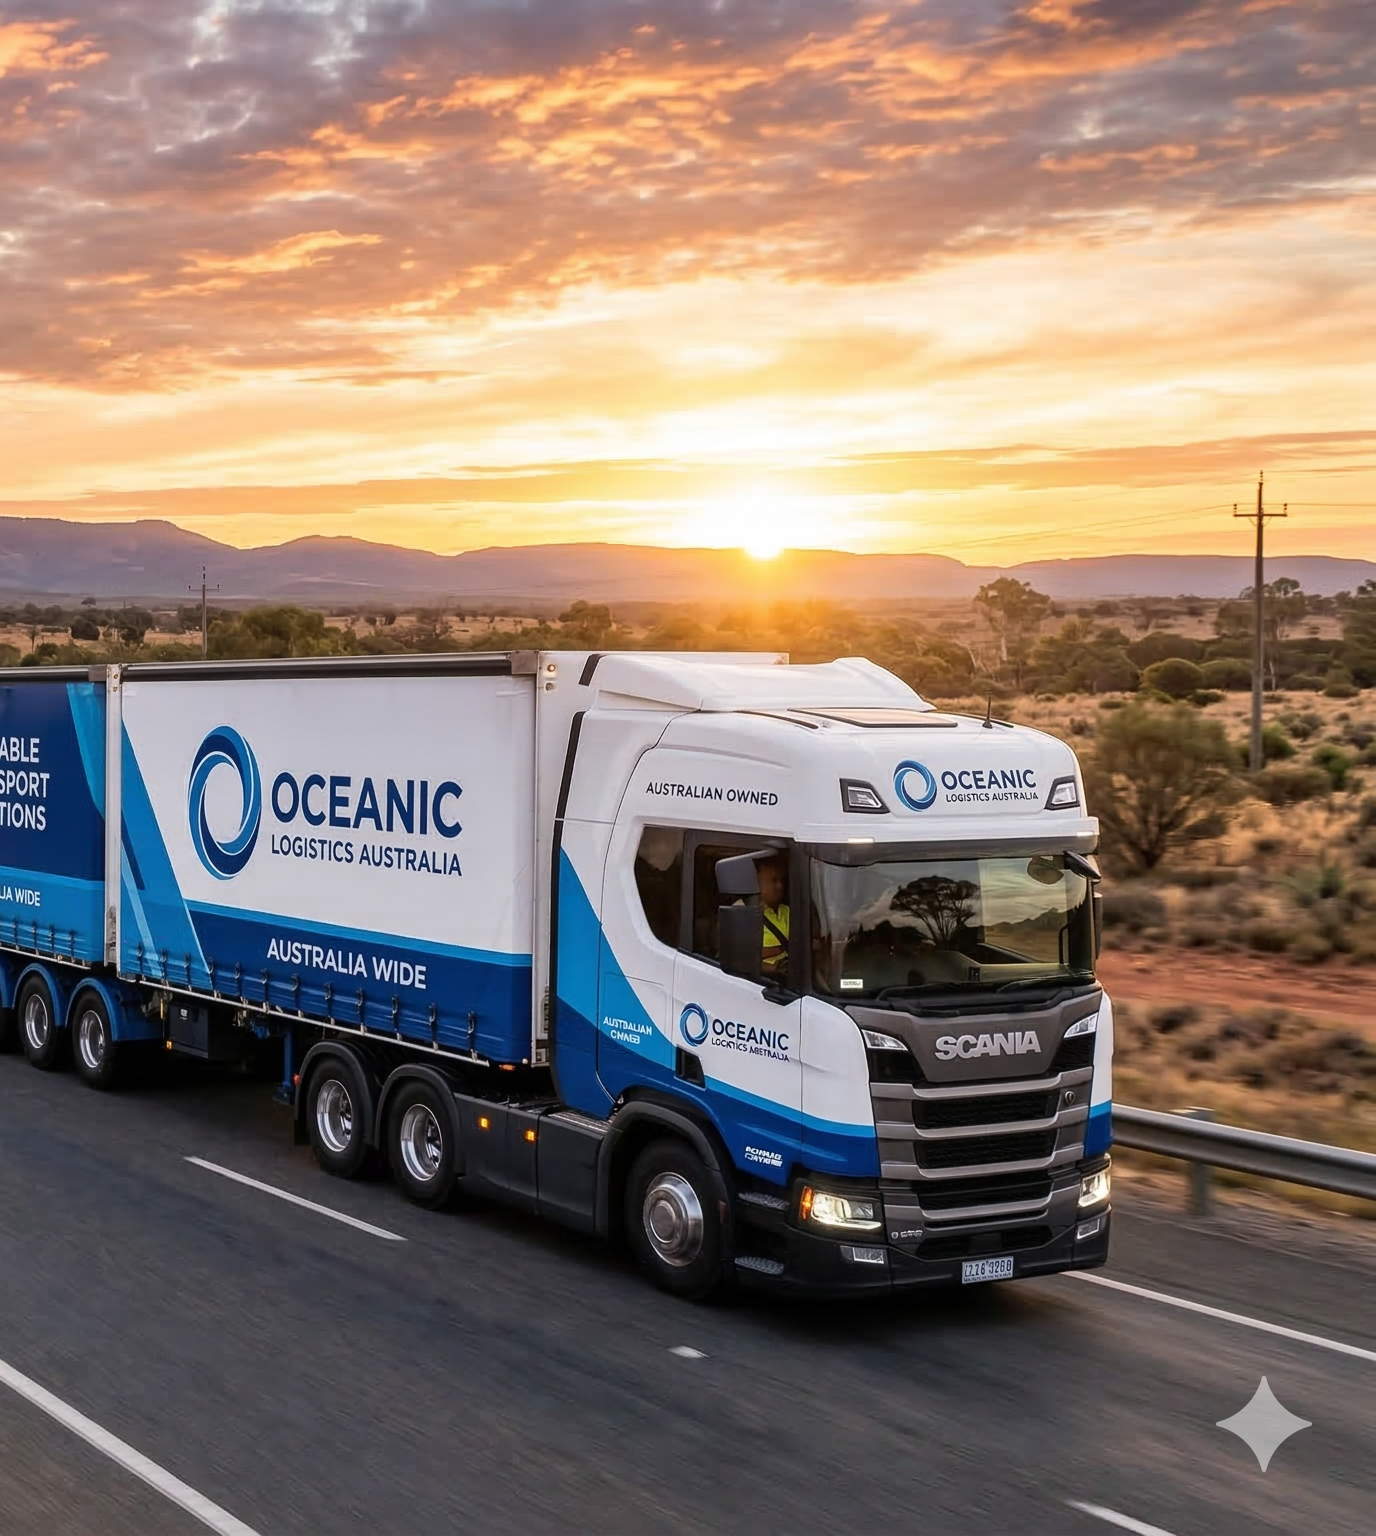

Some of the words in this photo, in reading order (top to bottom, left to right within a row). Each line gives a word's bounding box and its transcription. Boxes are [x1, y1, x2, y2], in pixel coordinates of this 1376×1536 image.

[645, 781, 723, 801] AUSTRALIAN
[726, 789, 779, 806] OWNED
[941, 769, 1036, 790] OCEANIC
[272, 771, 463, 838] OCEANIC
[945, 792, 990, 803] LOGISTICS
[991, 791, 1039, 802] AUSTRALIA
[271, 834, 354, 863] LOGISTICS
[358, 843, 463, 877] AUSTRALIA
[14, 887, 41, 907] WIDE
[267, 937, 368, 978] AUSTRALIA
[372, 956, 427, 990] WIDE
[712, 1018, 790, 1051] OCEANIC
[934, 1030, 1042, 1061] SCANIA
